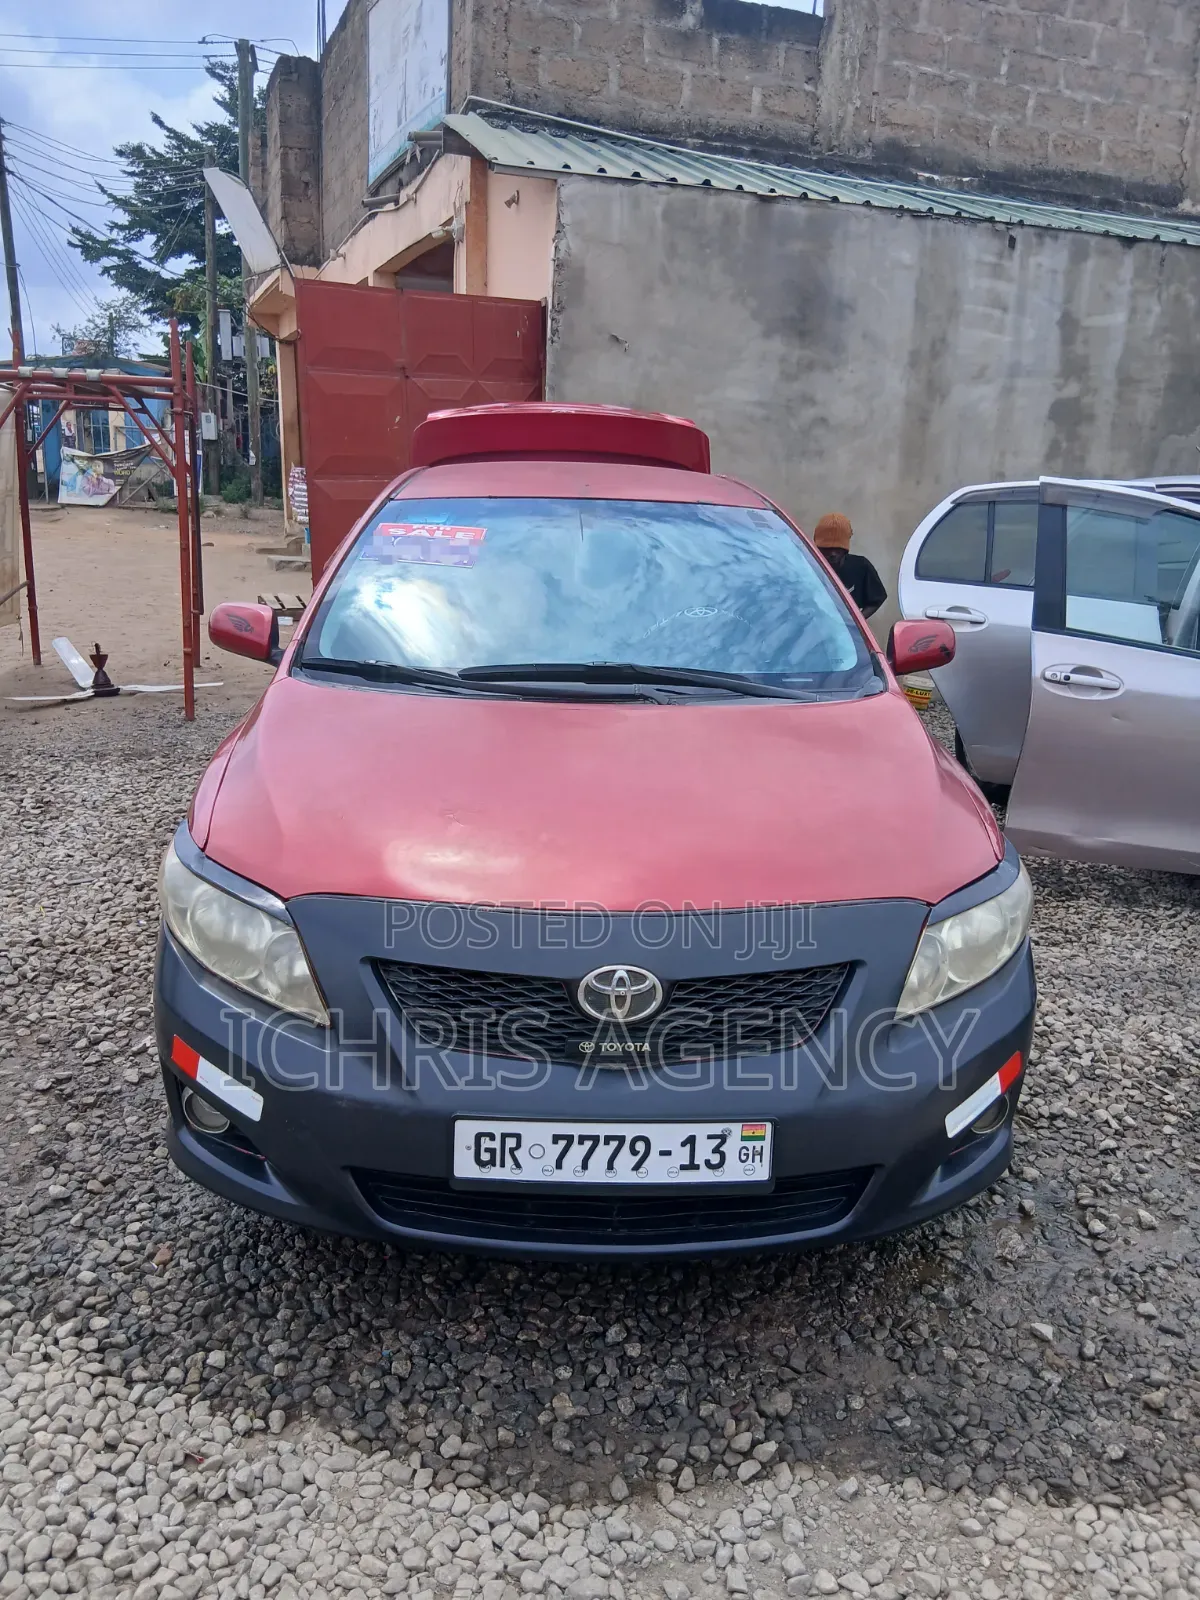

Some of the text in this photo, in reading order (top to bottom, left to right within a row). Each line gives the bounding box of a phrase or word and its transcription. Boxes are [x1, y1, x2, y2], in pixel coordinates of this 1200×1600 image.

[387, 528, 476, 540] SALE
[598, 1042, 652, 1052] TOYOTA
[474, 1132, 727, 1171] GR 7779-13
[738, 1145, 763, 1163] GH
